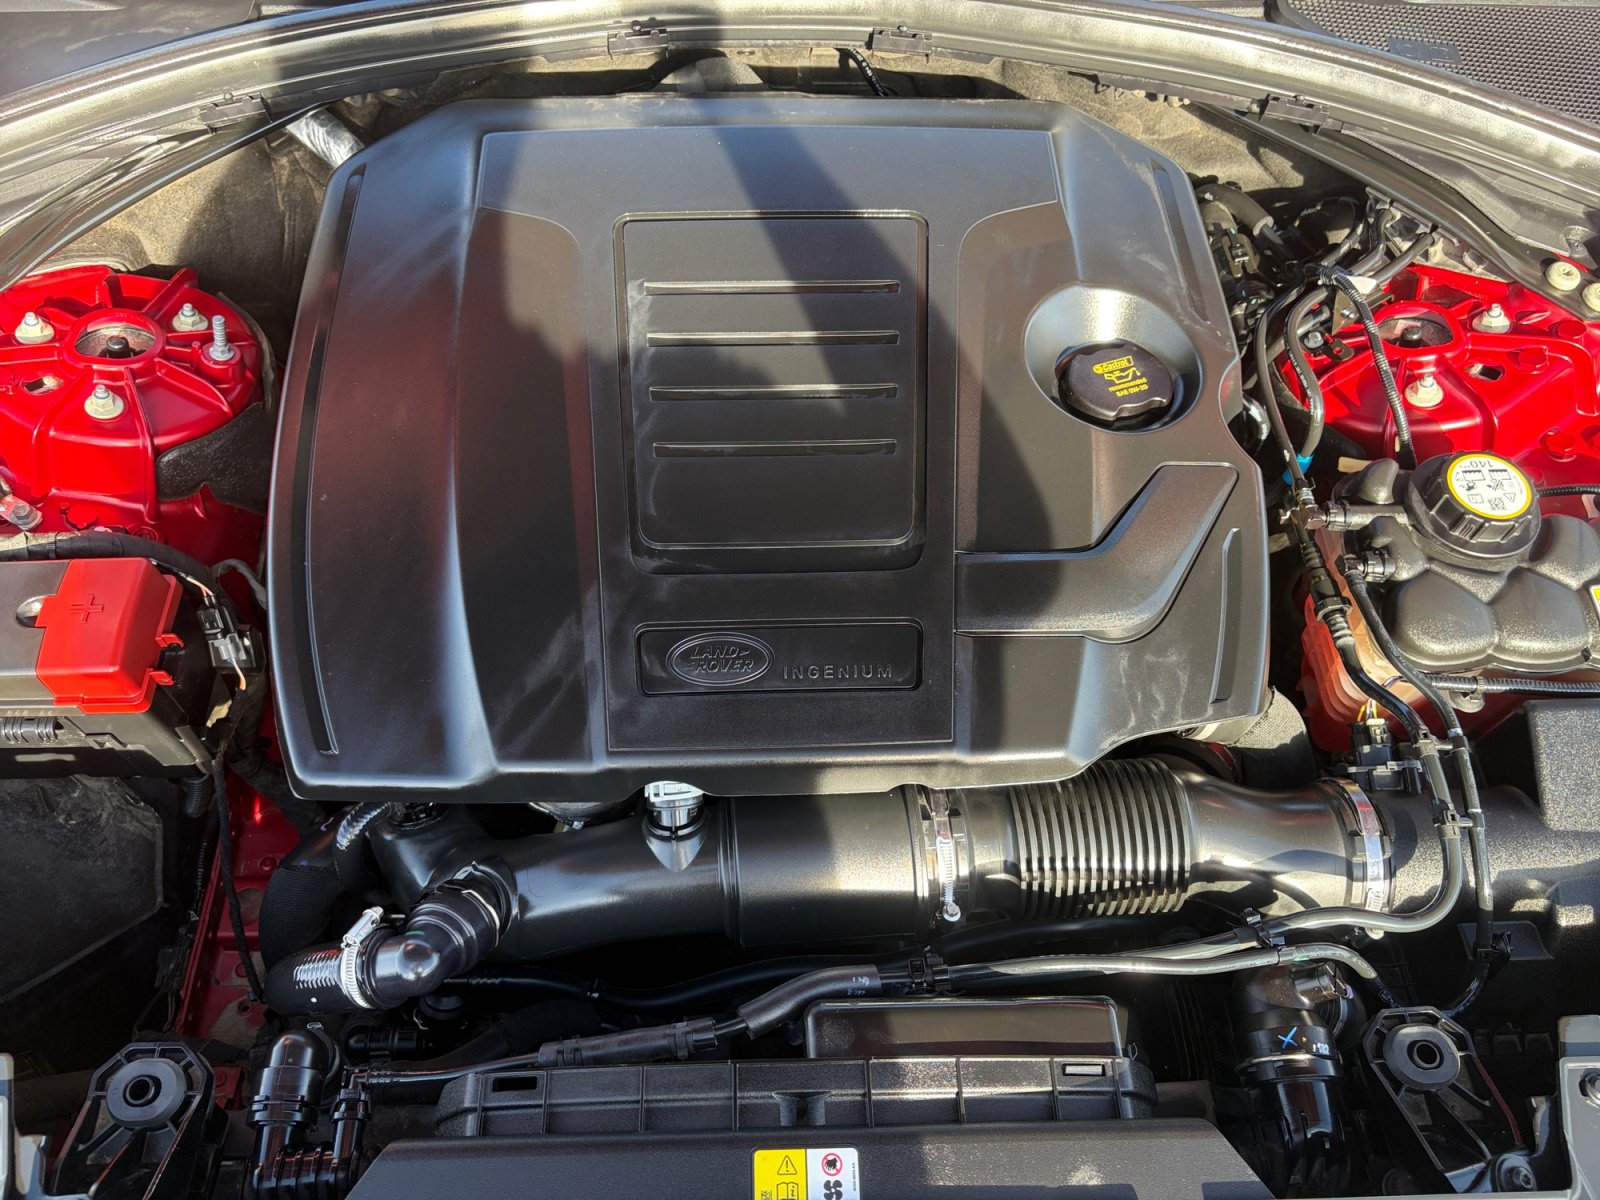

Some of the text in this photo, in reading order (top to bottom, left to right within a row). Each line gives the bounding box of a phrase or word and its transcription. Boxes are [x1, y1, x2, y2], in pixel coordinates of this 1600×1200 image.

[1102, 358, 1129, 371] Castrol
[690, 645, 738, 659] LAND
[696, 658, 754, 673] ROVER
[783, 664, 893, 680] INGENIUM
